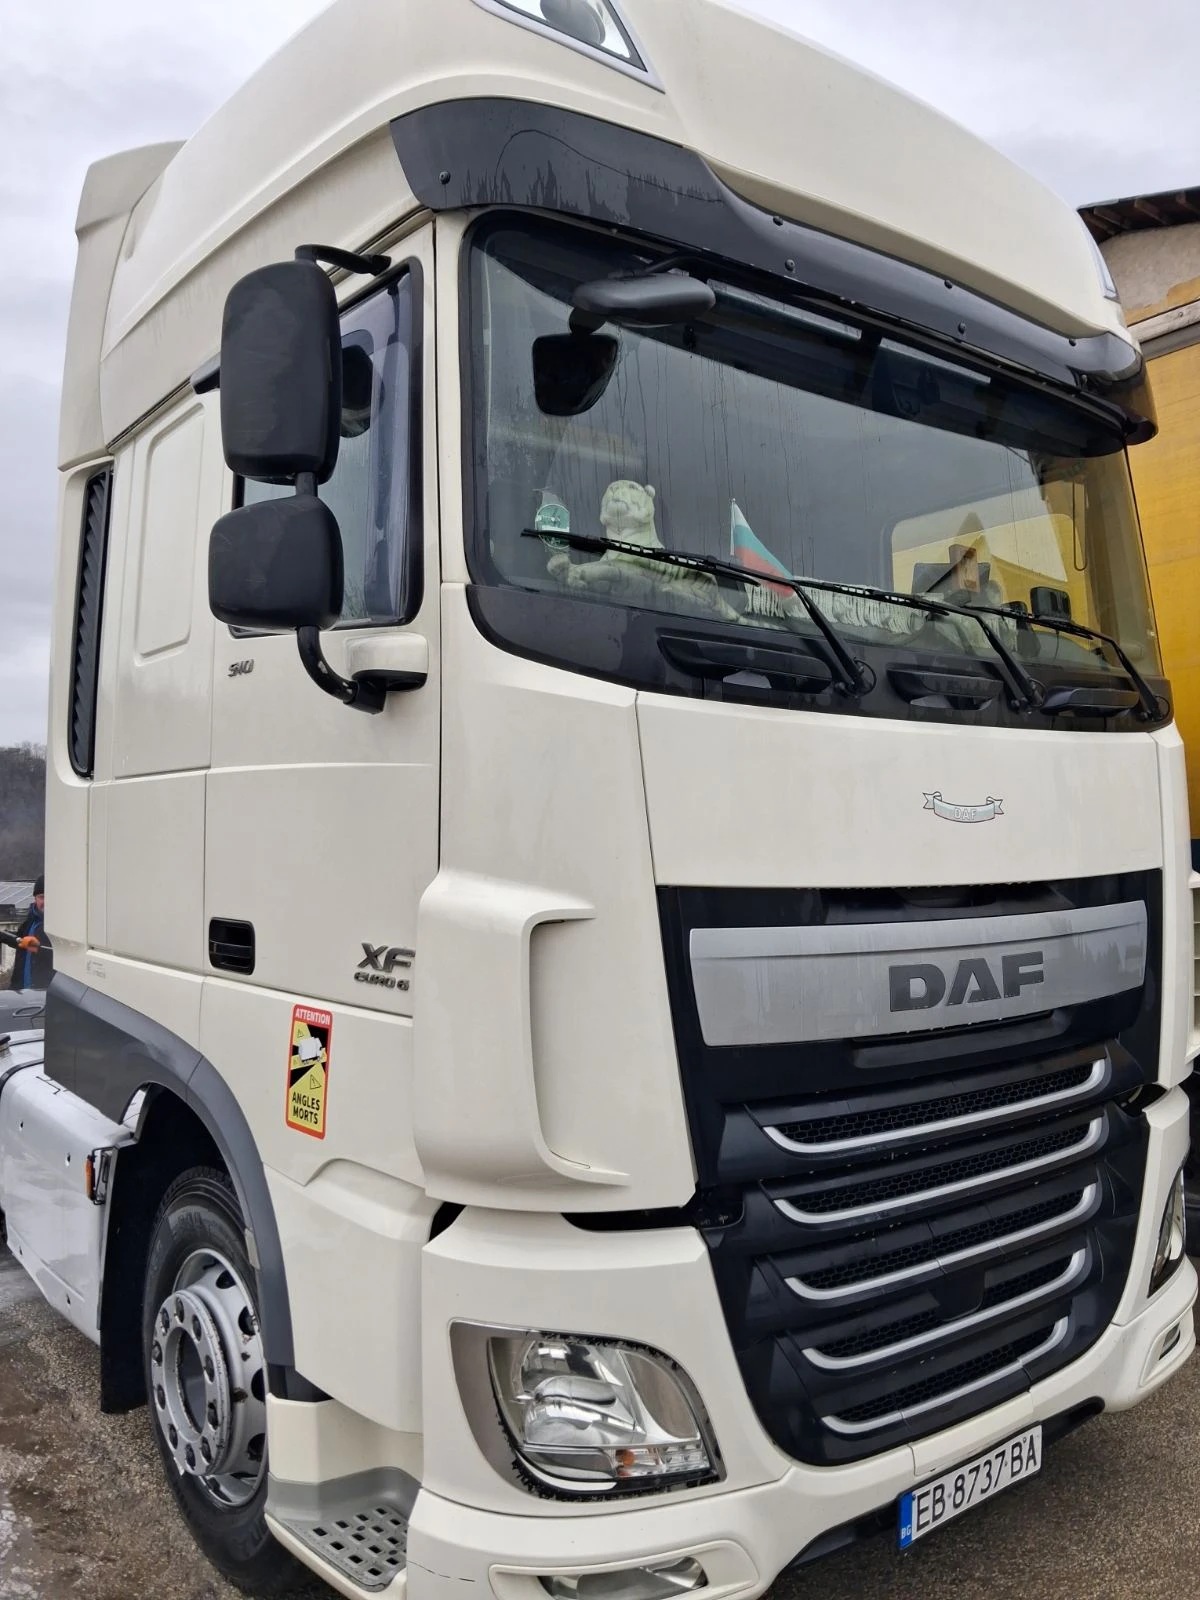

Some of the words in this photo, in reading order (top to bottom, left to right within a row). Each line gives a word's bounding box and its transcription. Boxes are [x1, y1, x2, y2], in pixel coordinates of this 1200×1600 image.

[954, 807, 977, 821] DAF
[357, 942, 416, 973] XF
[354, 972, 396, 988] EURO
[396, 979, 410, 991] 6
[888, 951, 1044, 1012] DAF
[295, 1008, 331, 1026] ATTENTION
[292, 1091, 320, 1111] ANGLES
[292, 1105, 319, 1125] MORTS
[900, 1524, 912, 1540] BG
